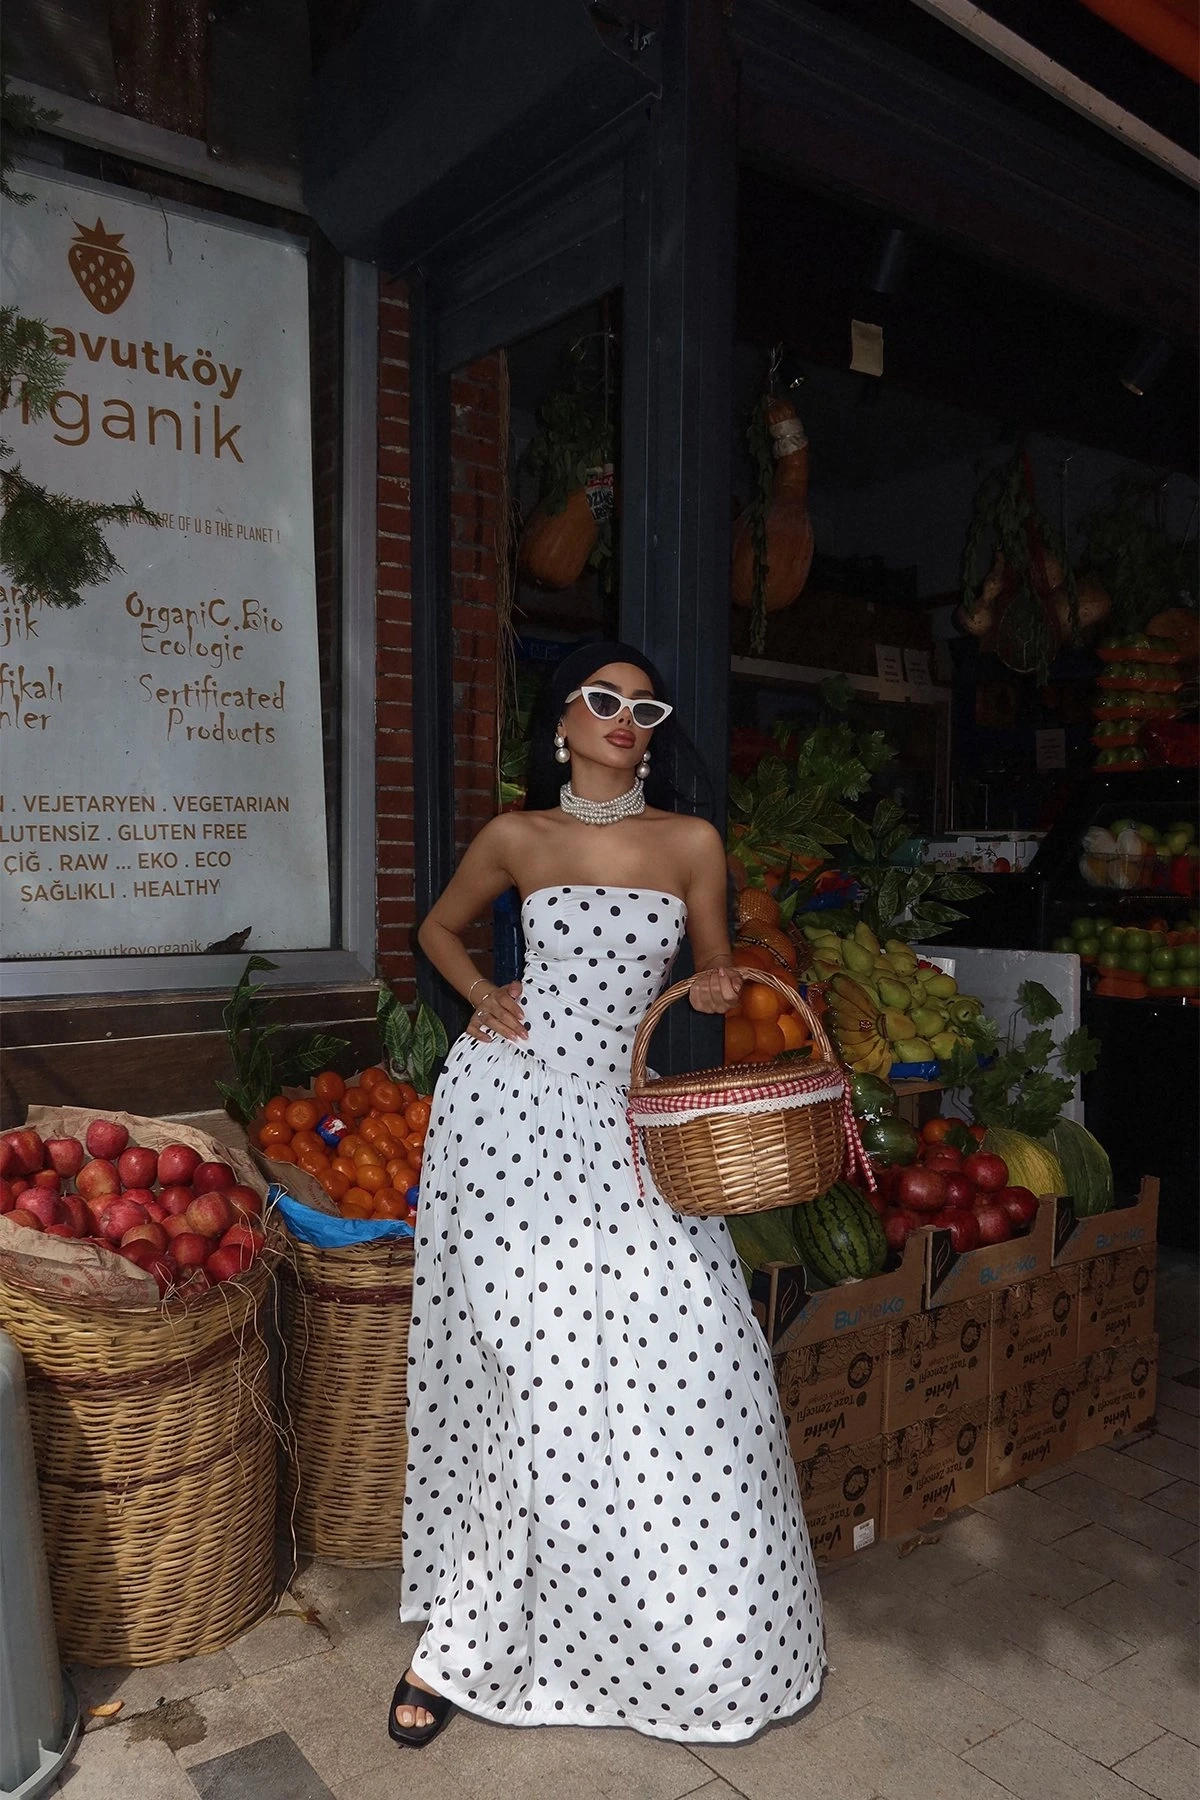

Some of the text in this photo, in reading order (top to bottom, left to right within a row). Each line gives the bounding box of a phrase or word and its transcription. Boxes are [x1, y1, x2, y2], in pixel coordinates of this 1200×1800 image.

[50, 326, 243, 400] avutköy
[178, 515, 191, 531] OF
[194, 518, 201, 533] U
[205, 519, 212, 535] &
[215, 521, 233, 539] THE
[237, 524, 273, 543] PLANET
[140, 622, 244, 669] Ecologic
[139, 673, 285, 712] Sertificated
[167, 707, 276, 745] Products
[23, 795, 156, 813] VEJETARYEN
[173, 796, 290, 813] VEGETARIAN
[118, 823, 196, 841] GLUTEN
[203, 823, 248, 840] FREE
[4, 851, 41, 876] ÇİĞ
[60, 854, 109, 872] RAW
[138, 852, 178, 869] EKO
[195, 851, 232, 868] ECO
[20, 878, 220, 902] SAĞLIKLI HEALTHY
[796, 1394, 855, 1424] Taze Zencefil
[830, 1507, 850, 1520] Taze
